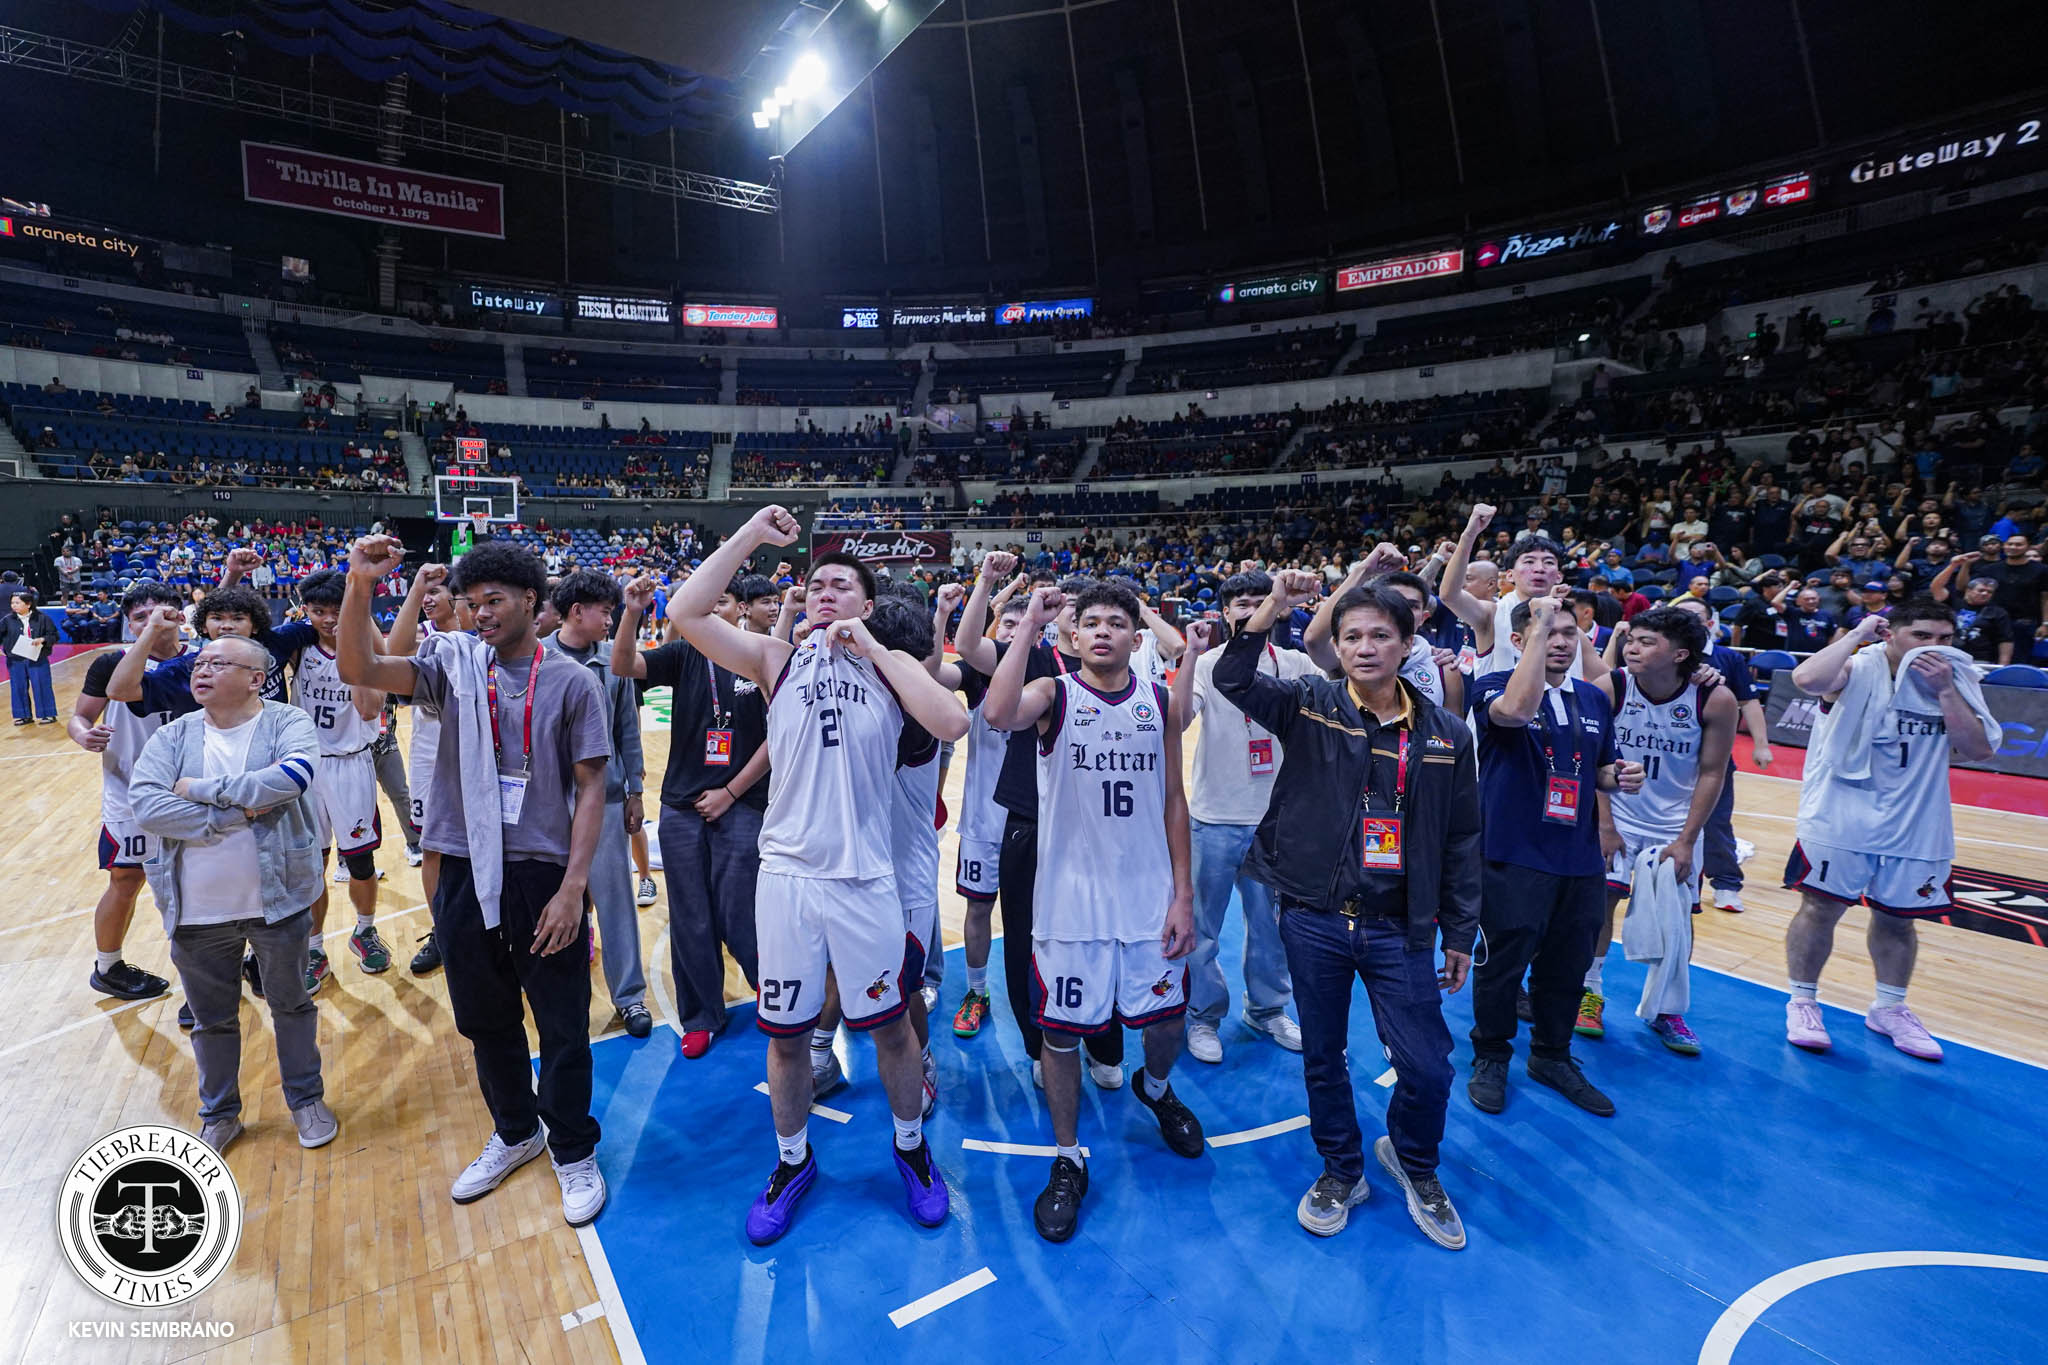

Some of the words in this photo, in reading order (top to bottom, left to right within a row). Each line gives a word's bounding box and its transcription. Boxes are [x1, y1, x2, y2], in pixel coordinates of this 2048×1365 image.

[2015, 119, 2041, 146] 2
[266, 157, 362, 194] "Thrilla
[366, 175, 394, 199] In
[397, 181, 484, 213] Manila"
[1766, 187, 1806, 205] Cignal
[333, 196, 387, 215] October
[388, 205, 400, 218] 1,
[401, 207, 430, 221] 1975
[1681, 207, 1717, 224] Cignal
[22, 224, 97, 248] araneta
[102, 237, 140, 257] city
[1500, 236, 1567, 264] Pizza
[1347, 256, 1451, 286] EMPERADOR
[1239, 283, 1287, 298] araneta
[1290, 278, 1318, 294] city
[578, 301, 614, 319] FIESTA
[614, 303, 670, 323] CARNIVAL
[708, 310, 747, 321] Tender
[745, 311, 777, 324] Juicy
[855, 312, 878, 320] TACO
[857, 319, 880, 328] BELL
[892, 312, 940, 325] Farmers
[942, 309, 987, 323] Market
[464, 448, 480, 460] 24
[213, 491, 231, 500] 110
[841, 538, 890, 557] Pizza
[889, 538, 930, 557] Hut
[1027, 533, 1042, 541] 112
[314, 705, 336, 729] 15
[819, 707, 842, 748] 2
[1136, 723, 1157, 732] SGA
[1617, 726, 1692, 754] Letran
[1643, 755, 1661, 780] 11
[1102, 780, 1134, 818] 16
[124, 834, 146, 857] 10
[963, 858, 982, 883] 18
[1819, 860, 1830, 883] 1
[763, 978, 802, 1012] 27
[1055, 976, 1084, 1009] 16
